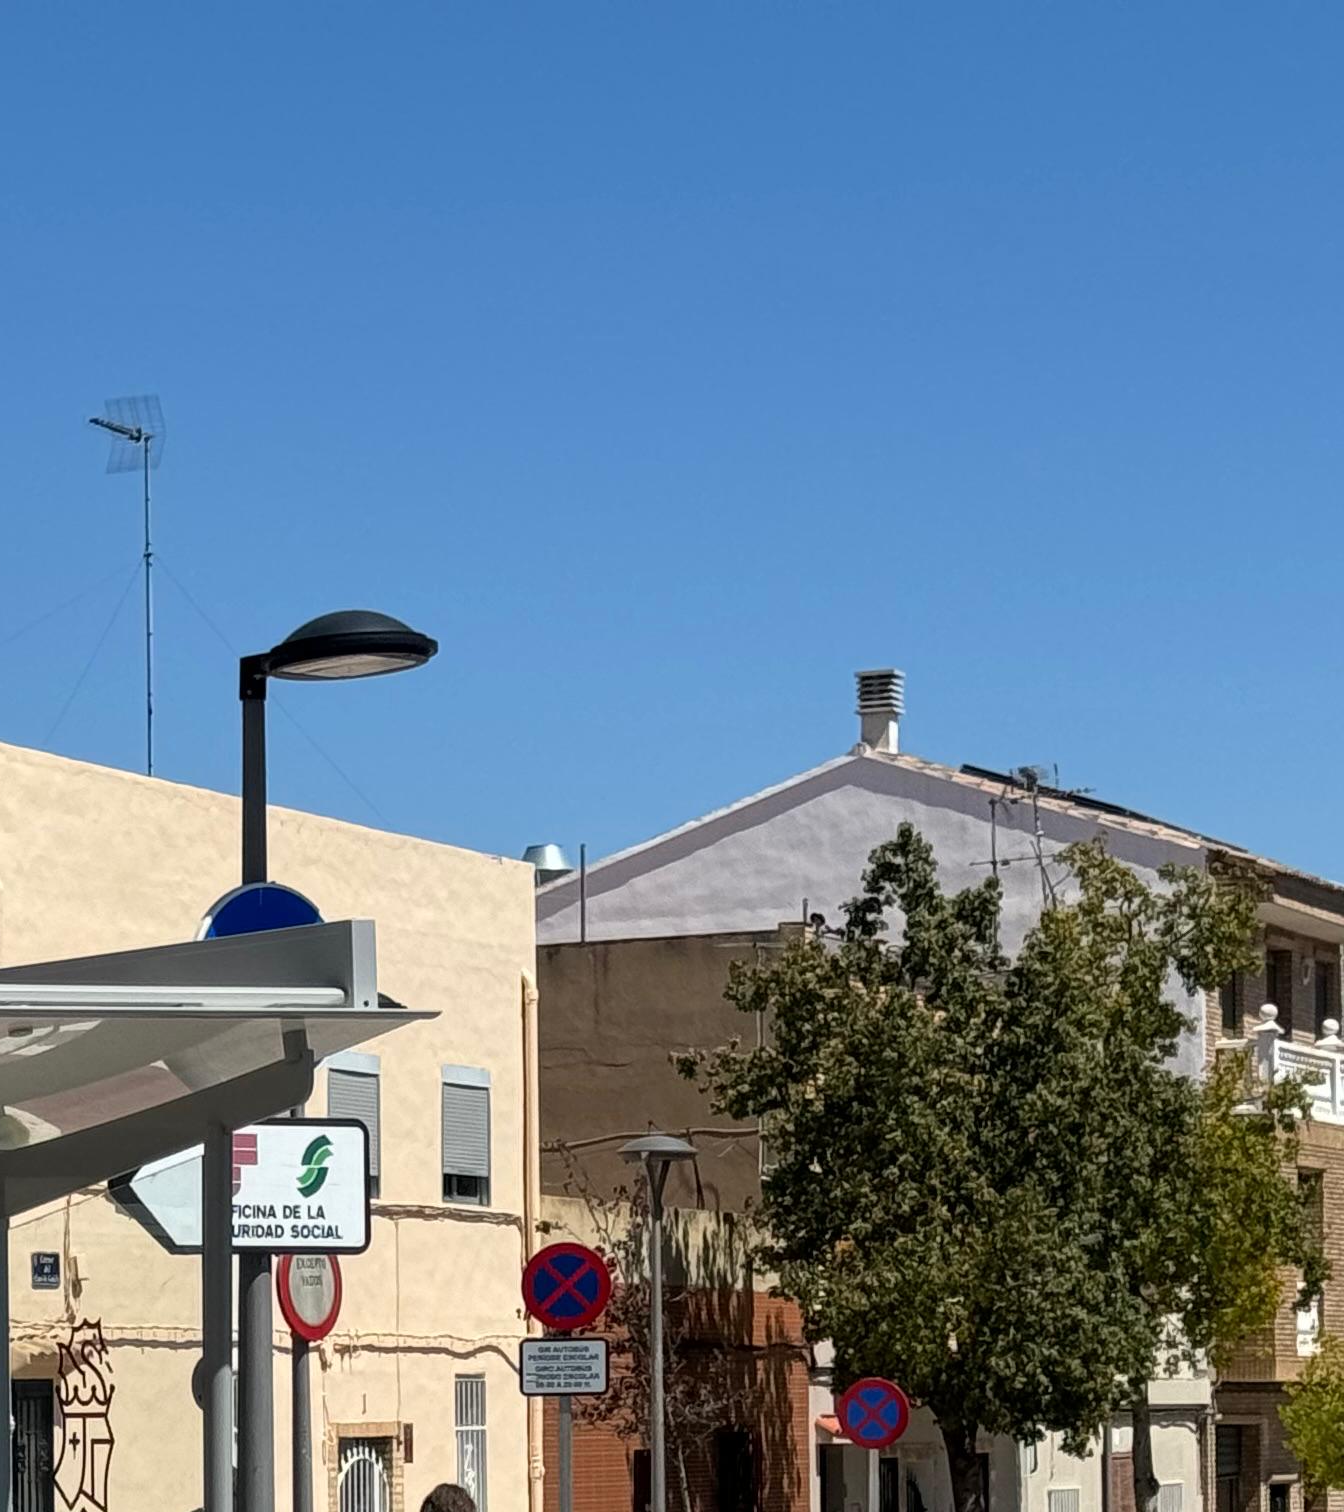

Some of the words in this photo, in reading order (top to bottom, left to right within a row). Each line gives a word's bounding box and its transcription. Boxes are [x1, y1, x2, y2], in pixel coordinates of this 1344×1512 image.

[232, 1204, 277, 1220] FICINA
[282, 1204, 302, 1220] DE
[307, 1204, 326, 1220] LA
[232, 1223, 284, 1239] URIDAD
[290, 1224, 344, 1240] SOCIAL
